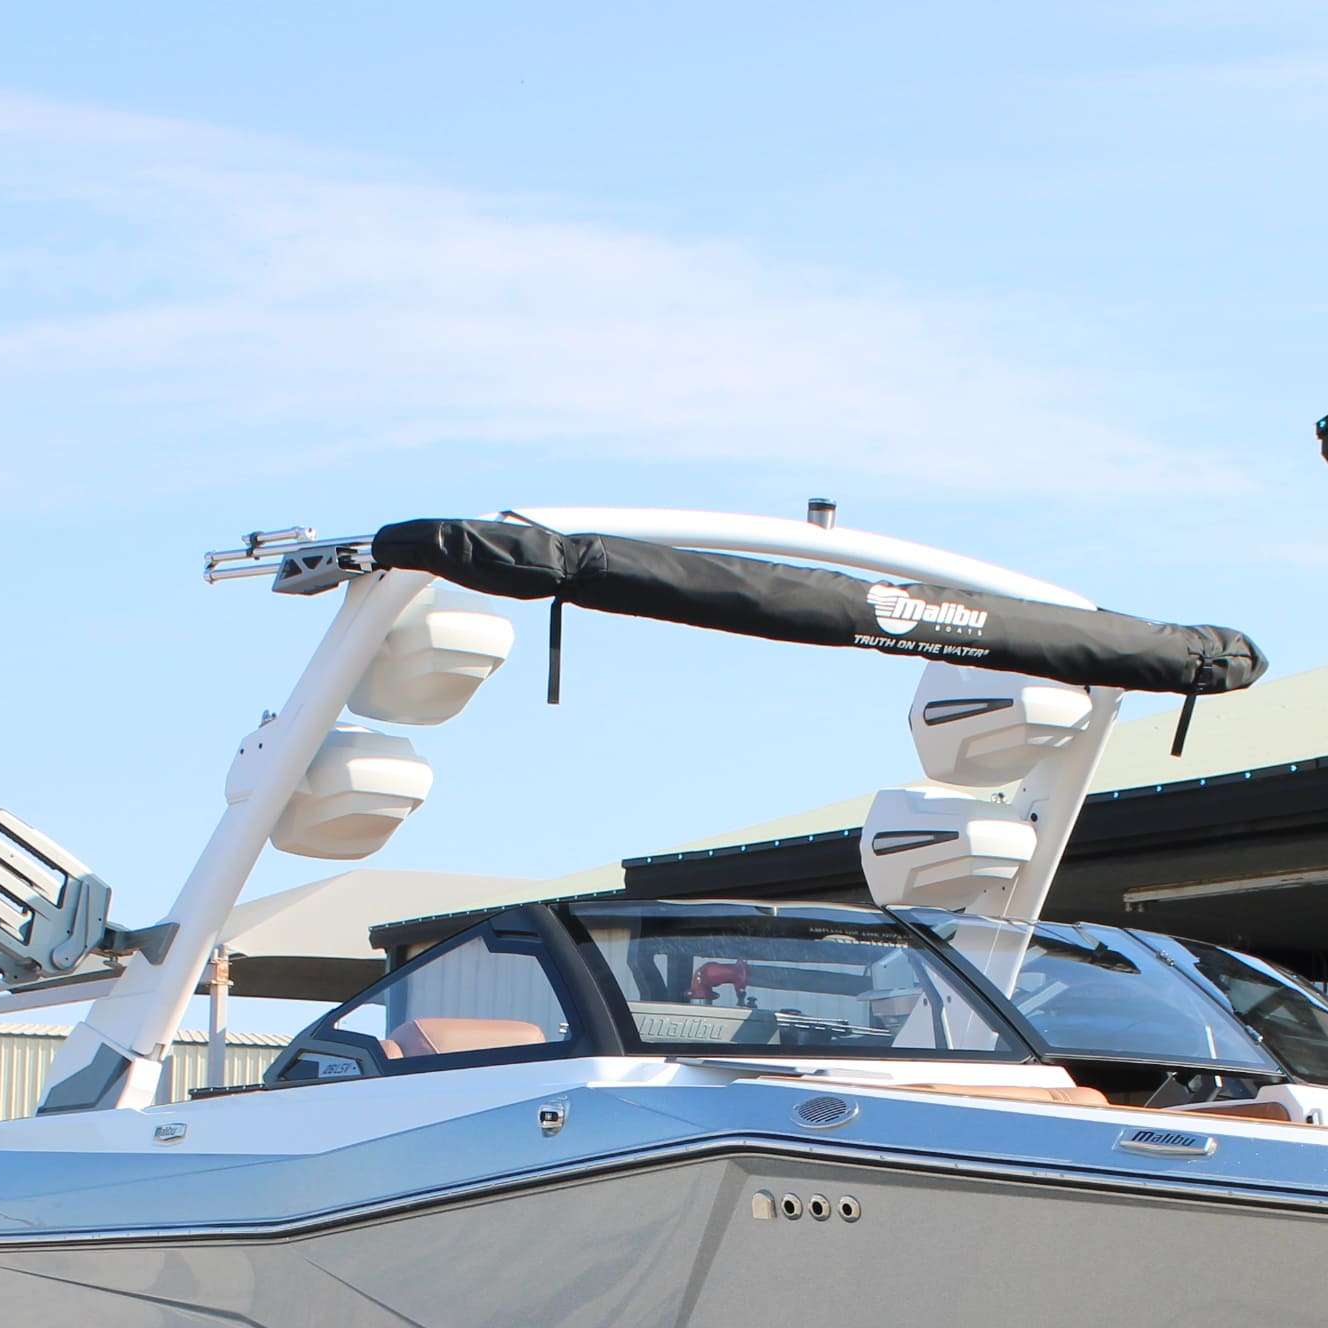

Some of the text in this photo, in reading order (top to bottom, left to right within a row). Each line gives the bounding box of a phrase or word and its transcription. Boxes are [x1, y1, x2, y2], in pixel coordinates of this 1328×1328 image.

[893, 597, 988, 629] Malibu
[935, 625, 983, 637] BOATS
[853, 634, 896, 649] TRUTH
[896, 639, 915, 651] ON
[917, 642, 940, 655] THE
[1132, 1130, 1196, 1147] Malibu
